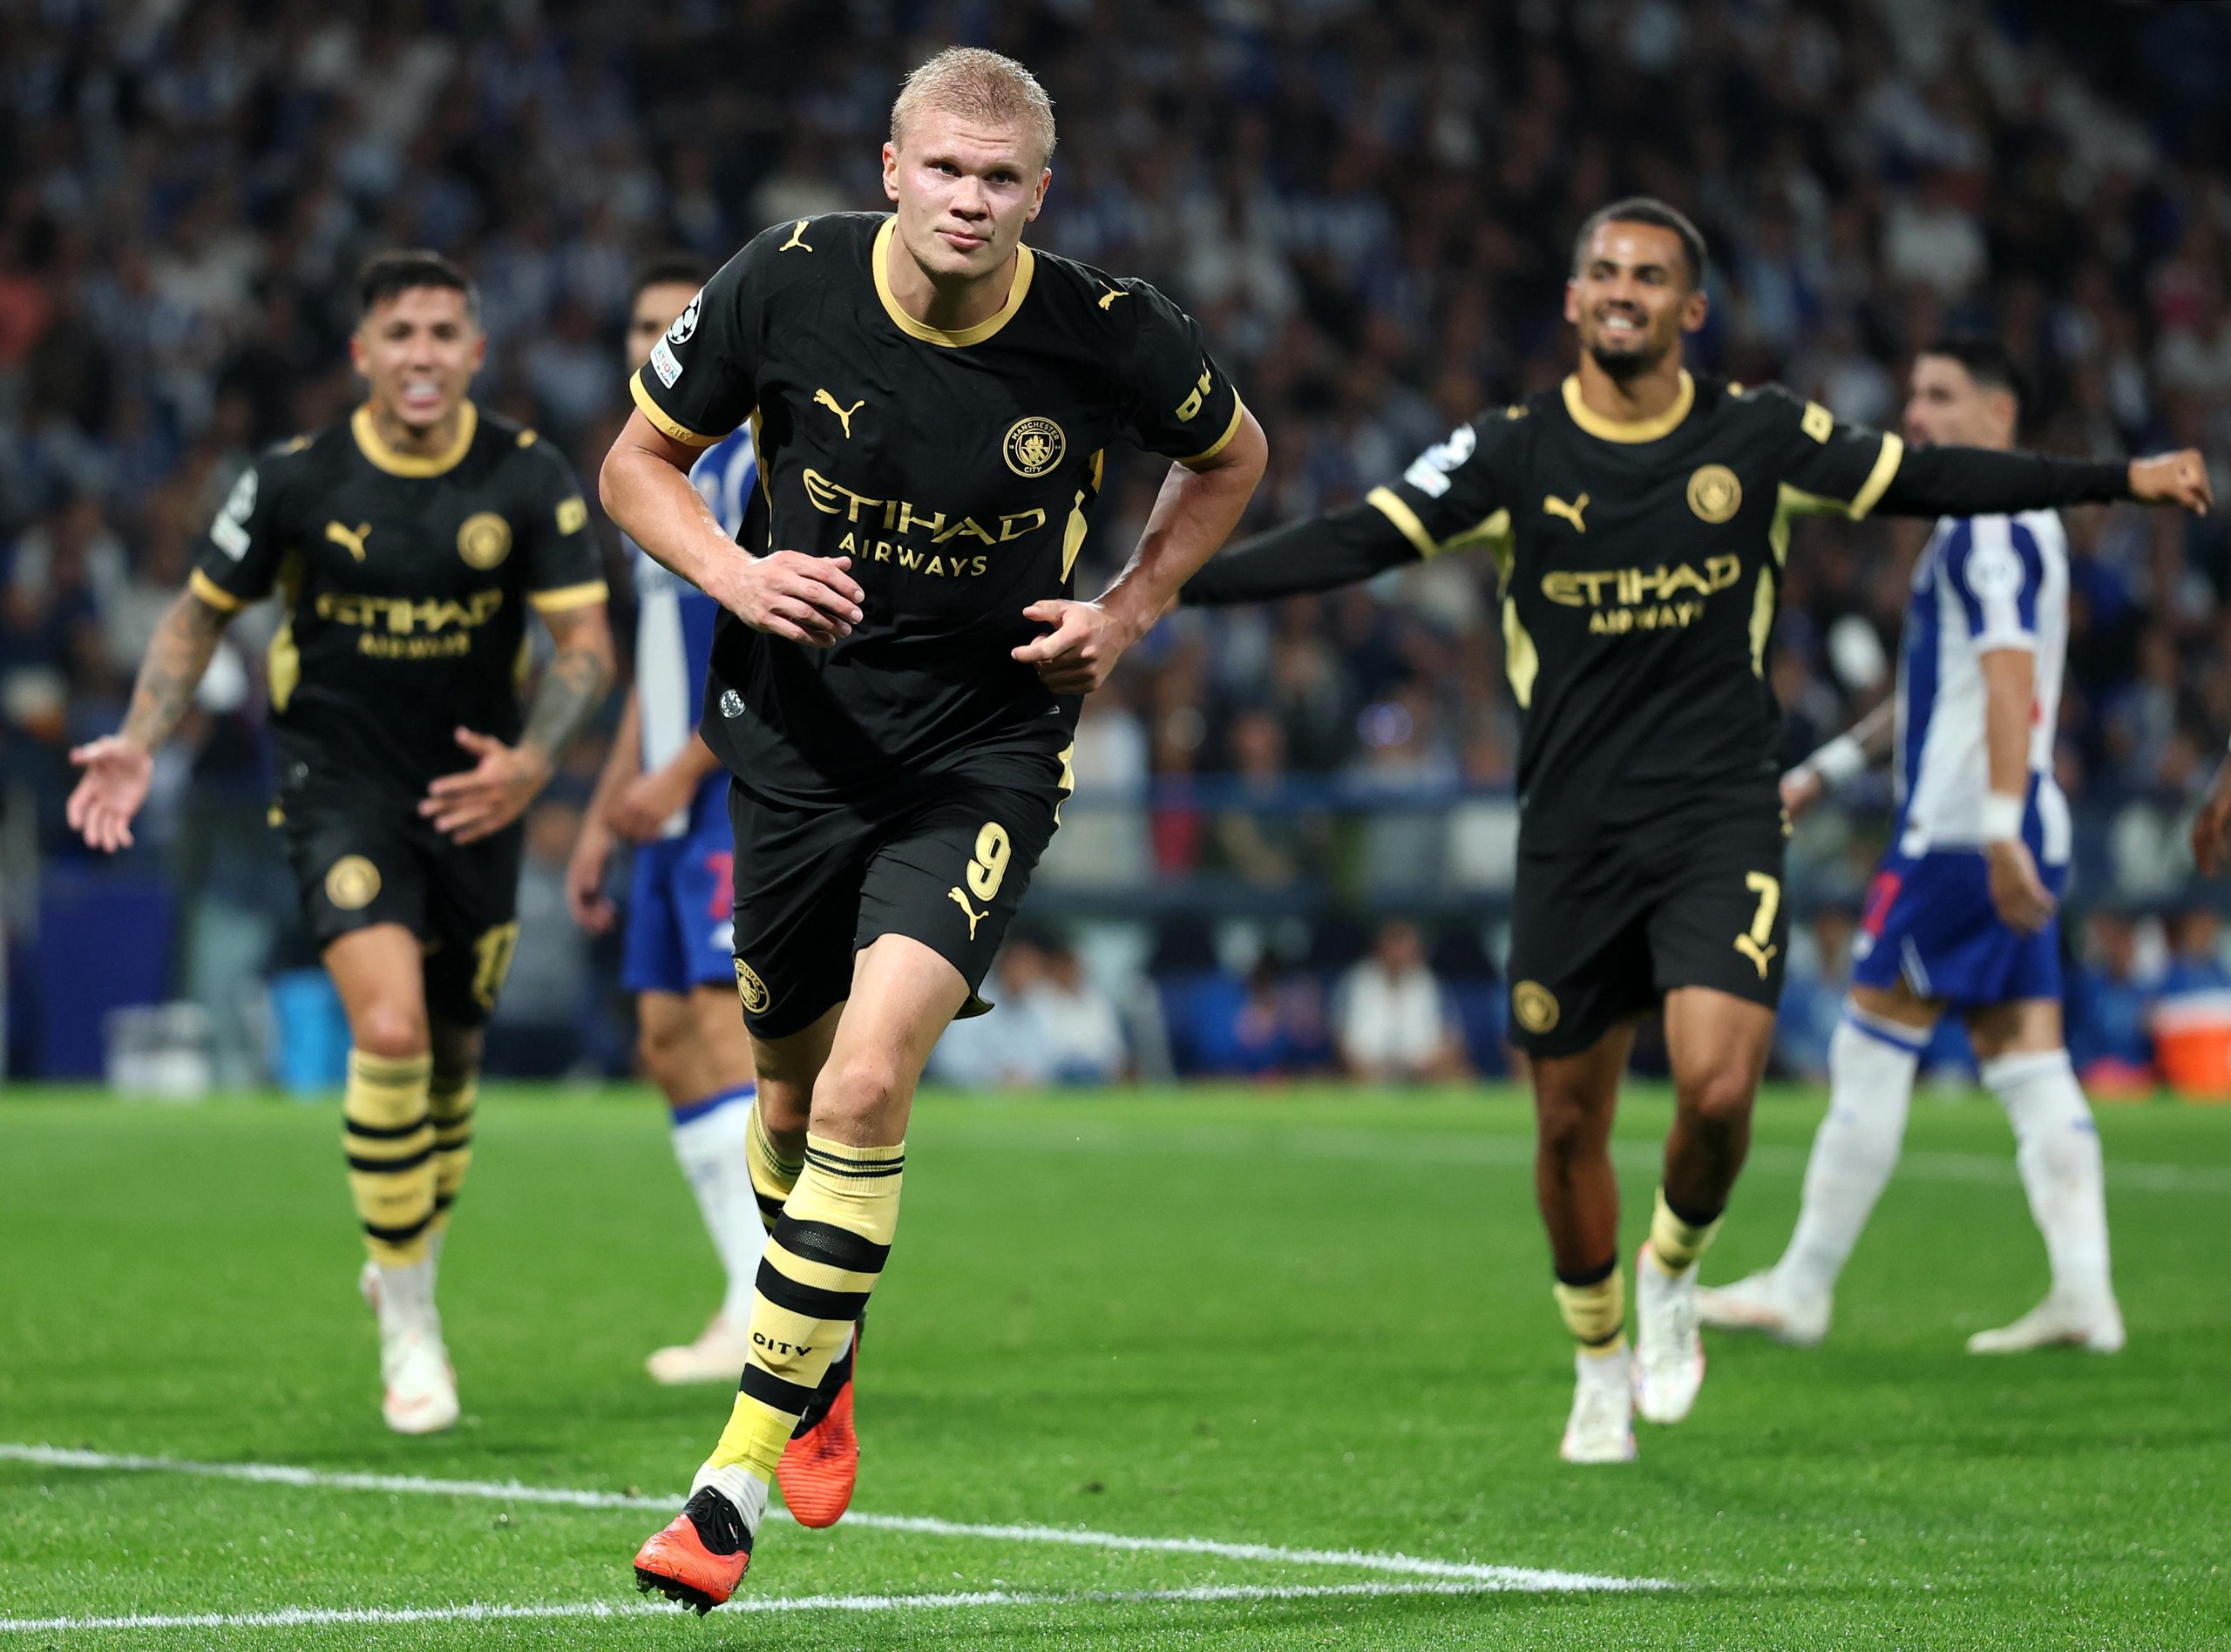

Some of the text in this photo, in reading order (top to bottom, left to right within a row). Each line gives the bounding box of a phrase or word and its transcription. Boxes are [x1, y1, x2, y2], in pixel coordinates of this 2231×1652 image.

[656, 349, 677, 381] ATION
[1011, 421, 1060, 441] MANCHESTER
[802, 468, 1046, 545] ETIHAD
[838, 531, 987, 577] AIRWAYS
[1540, 552, 1742, 608] ETIHAD
[966, 822, 1011, 902] 9
[1745, 870, 1780, 947] 7
[753, 1331, 812, 1357] CITY
